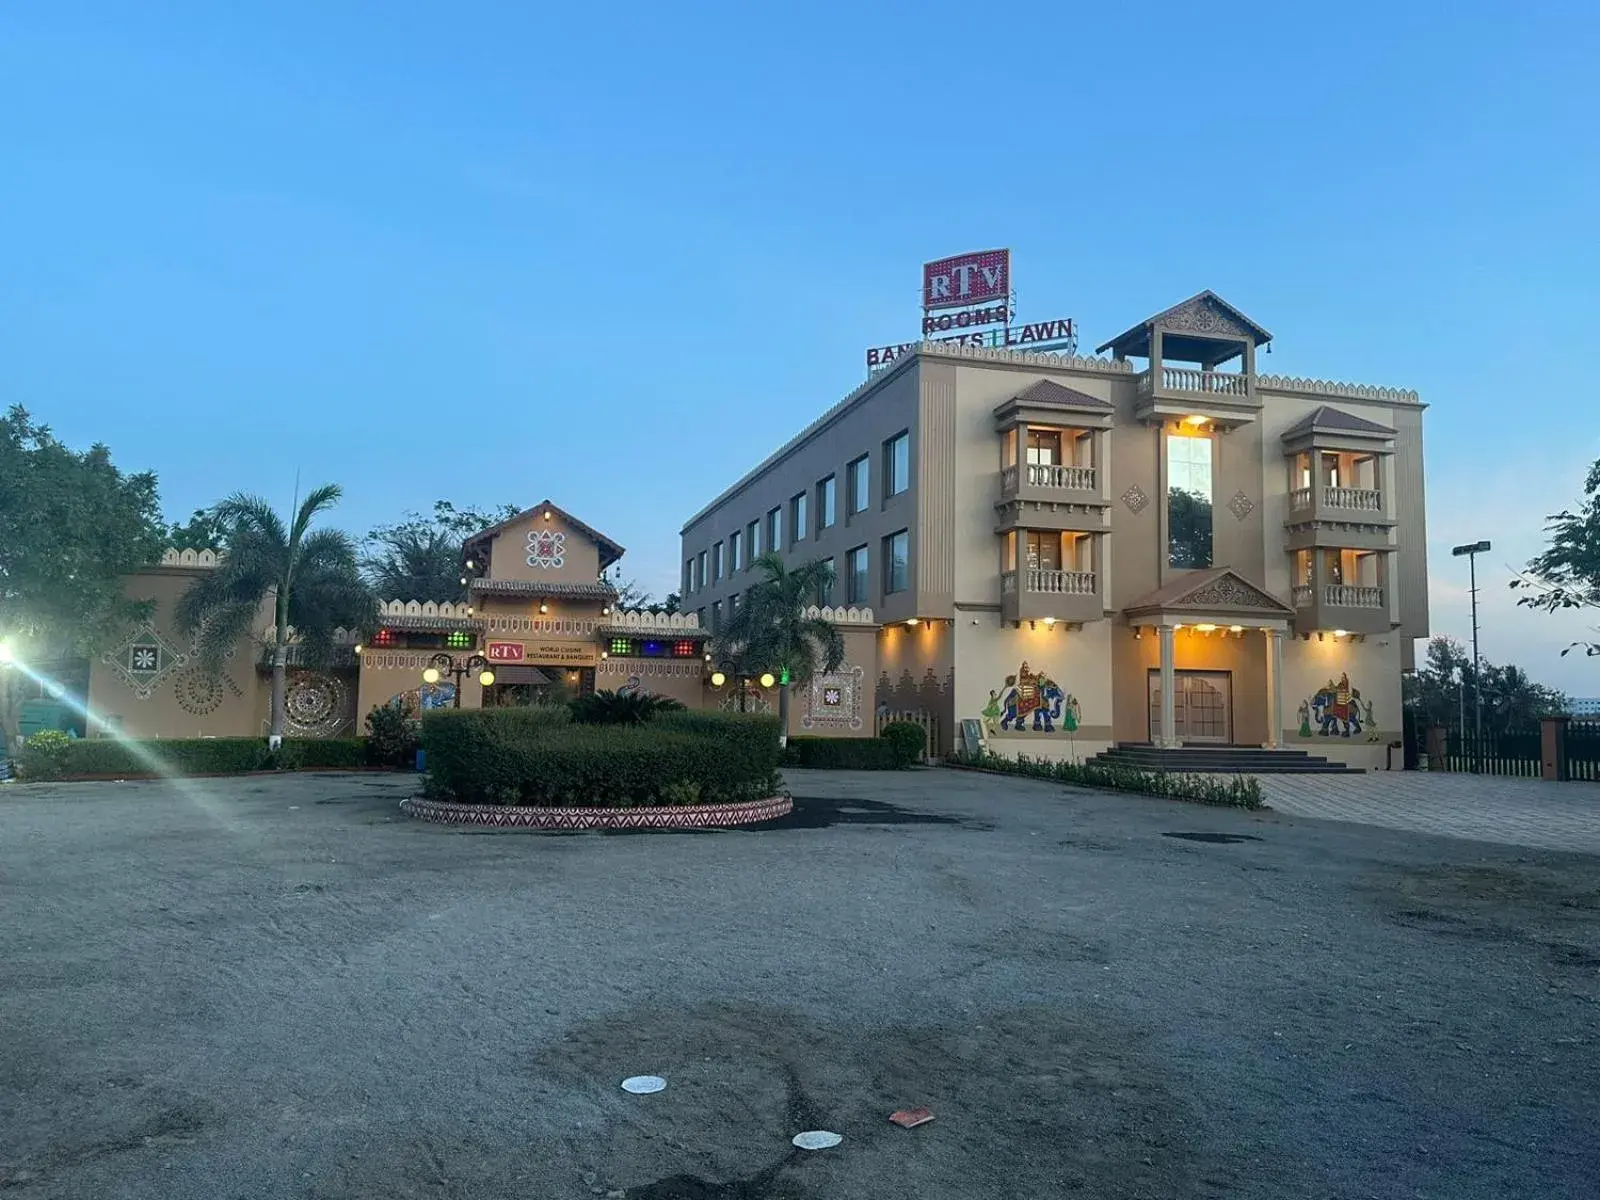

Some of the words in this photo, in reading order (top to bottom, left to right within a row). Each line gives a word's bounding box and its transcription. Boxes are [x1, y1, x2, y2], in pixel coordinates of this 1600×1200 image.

[928, 263, 1004, 299] RTV
[922, 305, 1008, 335] ROOMS
[1004, 318, 1073, 346] LAWN
[490, 645, 521, 658] RTV
